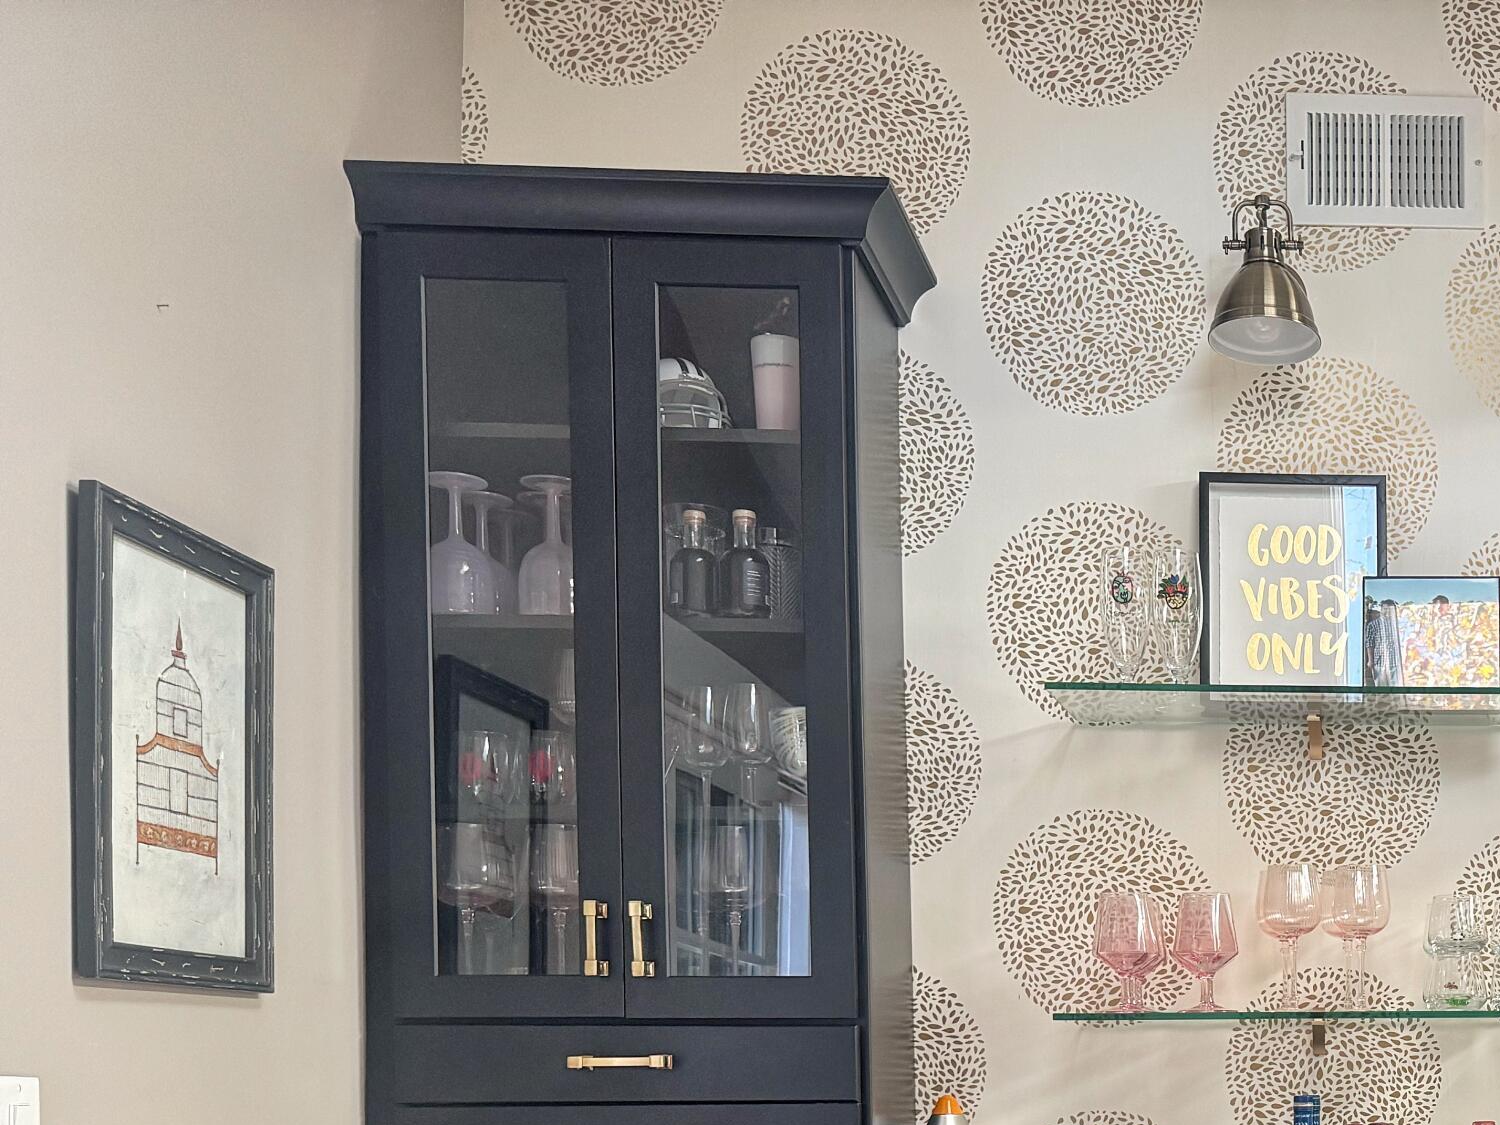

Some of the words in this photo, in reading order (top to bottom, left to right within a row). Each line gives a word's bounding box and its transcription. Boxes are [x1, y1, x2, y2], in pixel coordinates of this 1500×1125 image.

[1247, 523, 1342, 566] GOOD
[1240, 574, 1351, 624] VIBES
[1246, 631, 1349, 676] ONLY
